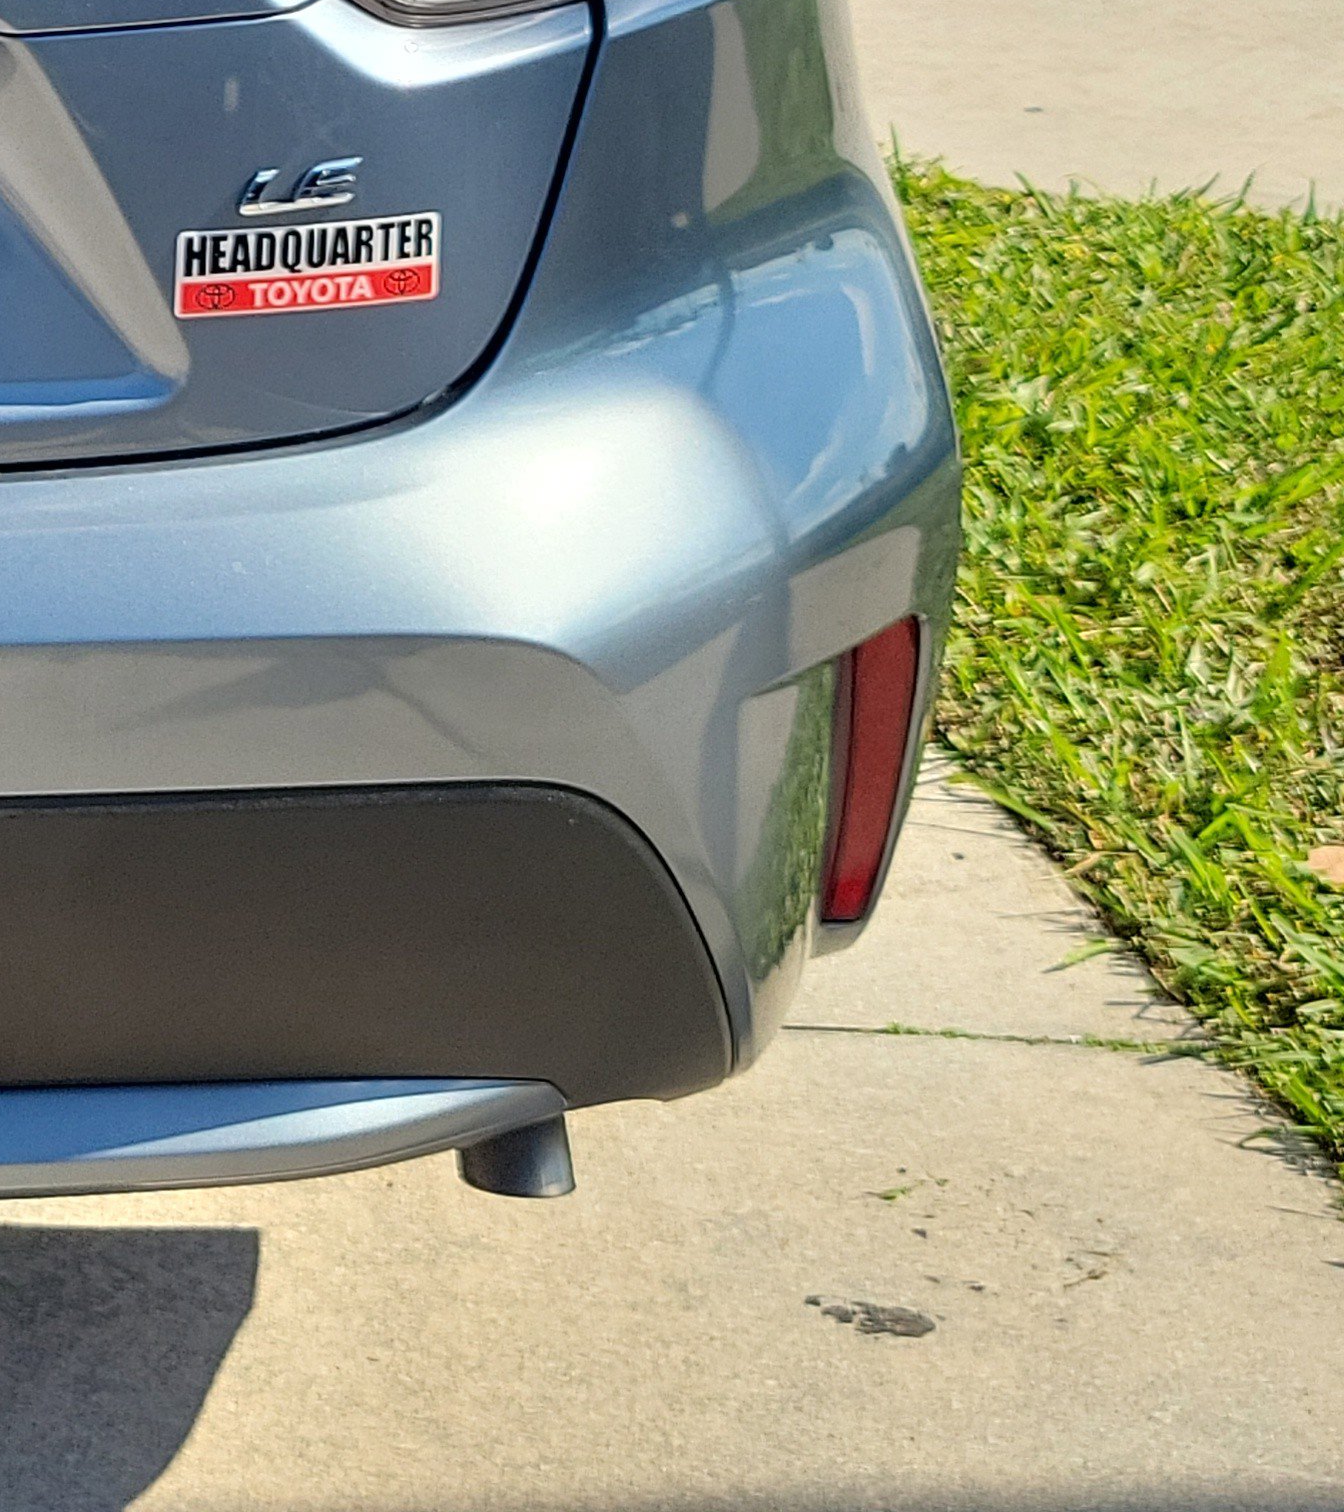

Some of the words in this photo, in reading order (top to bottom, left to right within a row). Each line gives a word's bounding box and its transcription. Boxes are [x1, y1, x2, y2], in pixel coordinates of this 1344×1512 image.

[238, 155, 364, 217] LE
[183, 218, 434, 277] HEADQUARTER
[247, 274, 376, 308] TOYOTA
